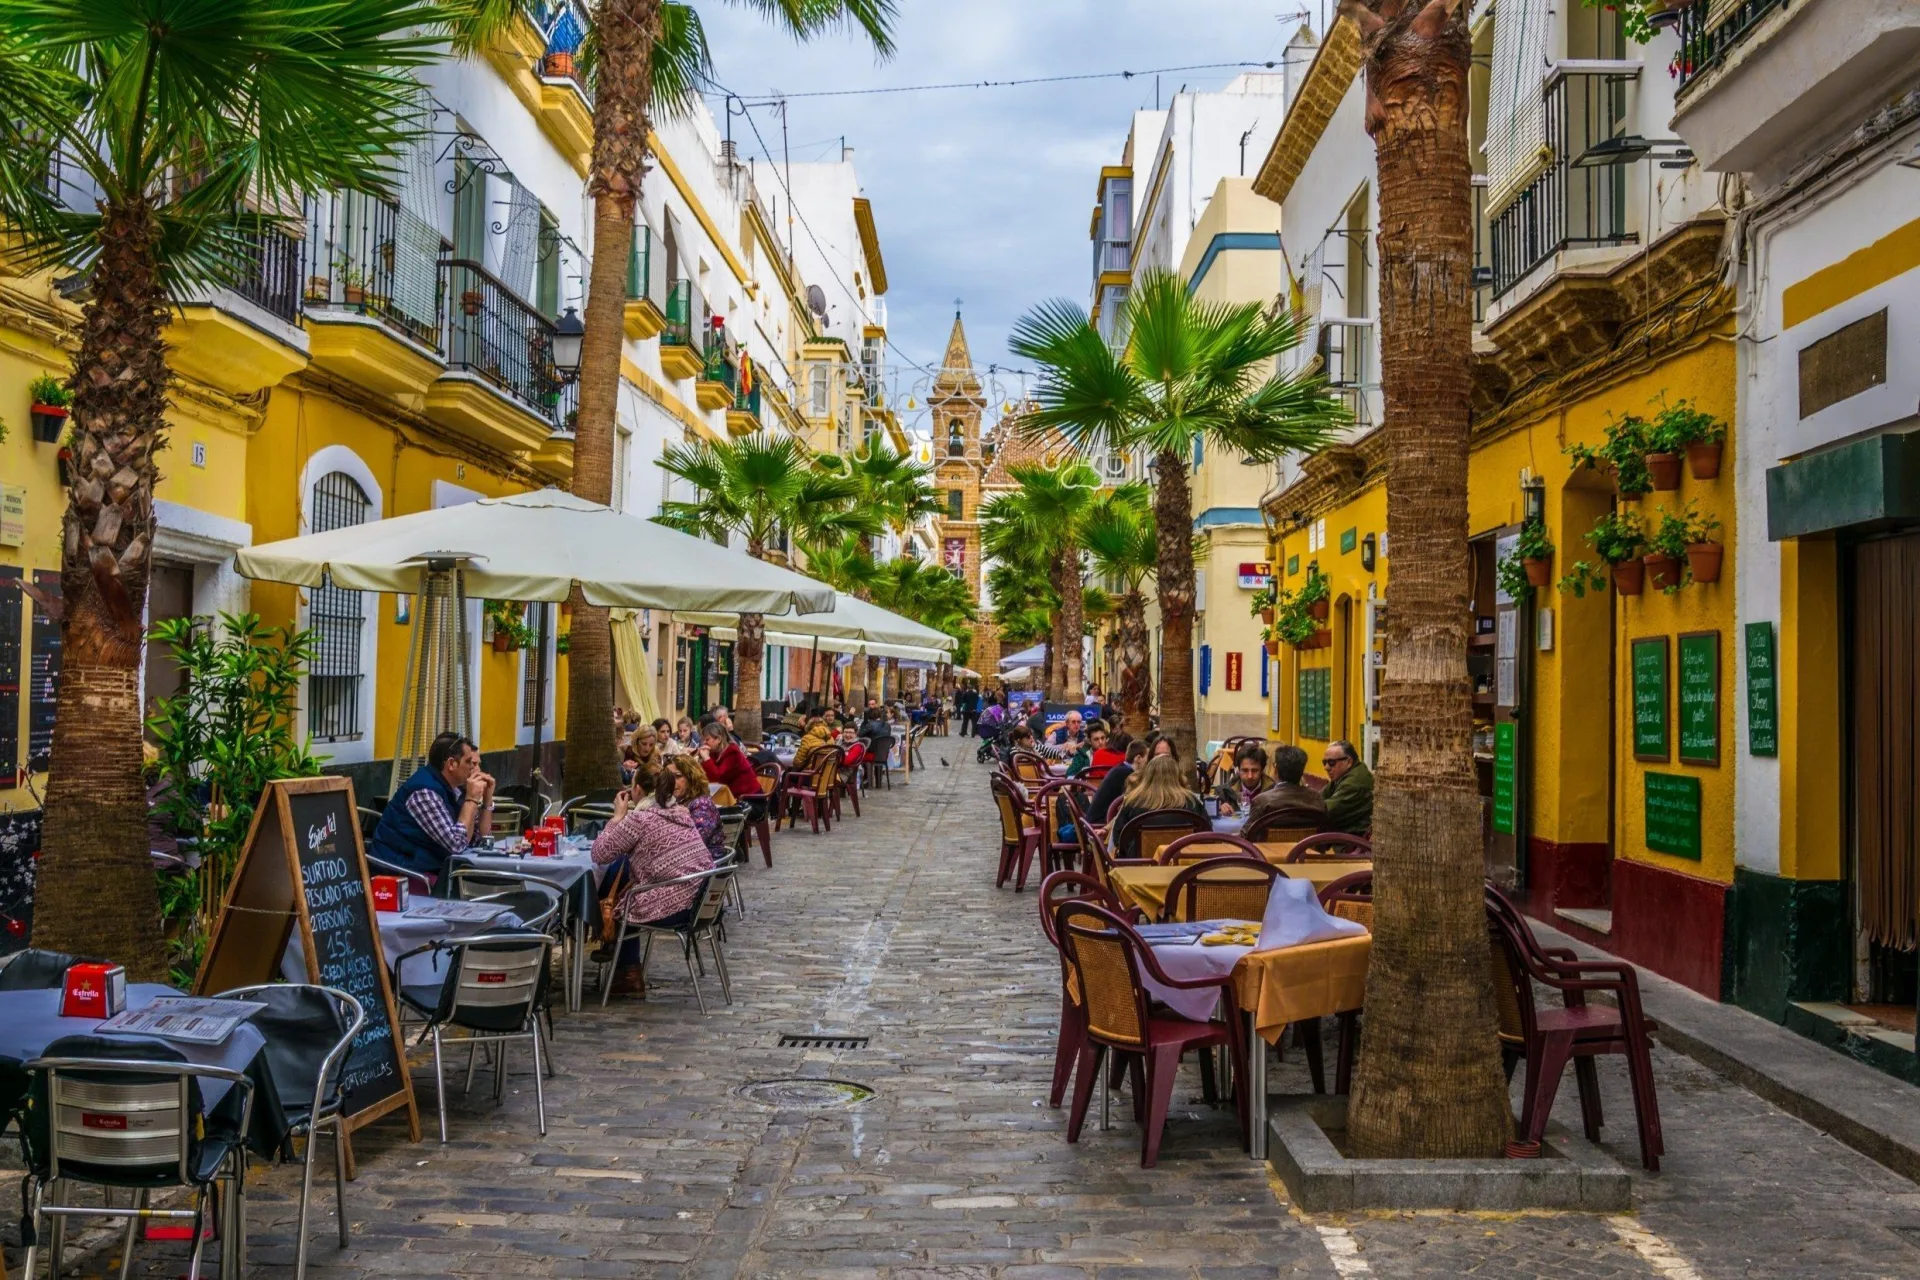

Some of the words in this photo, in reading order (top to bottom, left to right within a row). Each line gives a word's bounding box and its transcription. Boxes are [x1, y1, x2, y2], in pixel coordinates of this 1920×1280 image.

[195, 446, 204, 464] 15
[305, 885, 341, 908] PESCADO
[348, 974, 374, 993] CHOCO
[73, 989, 99, 998] Estrella
